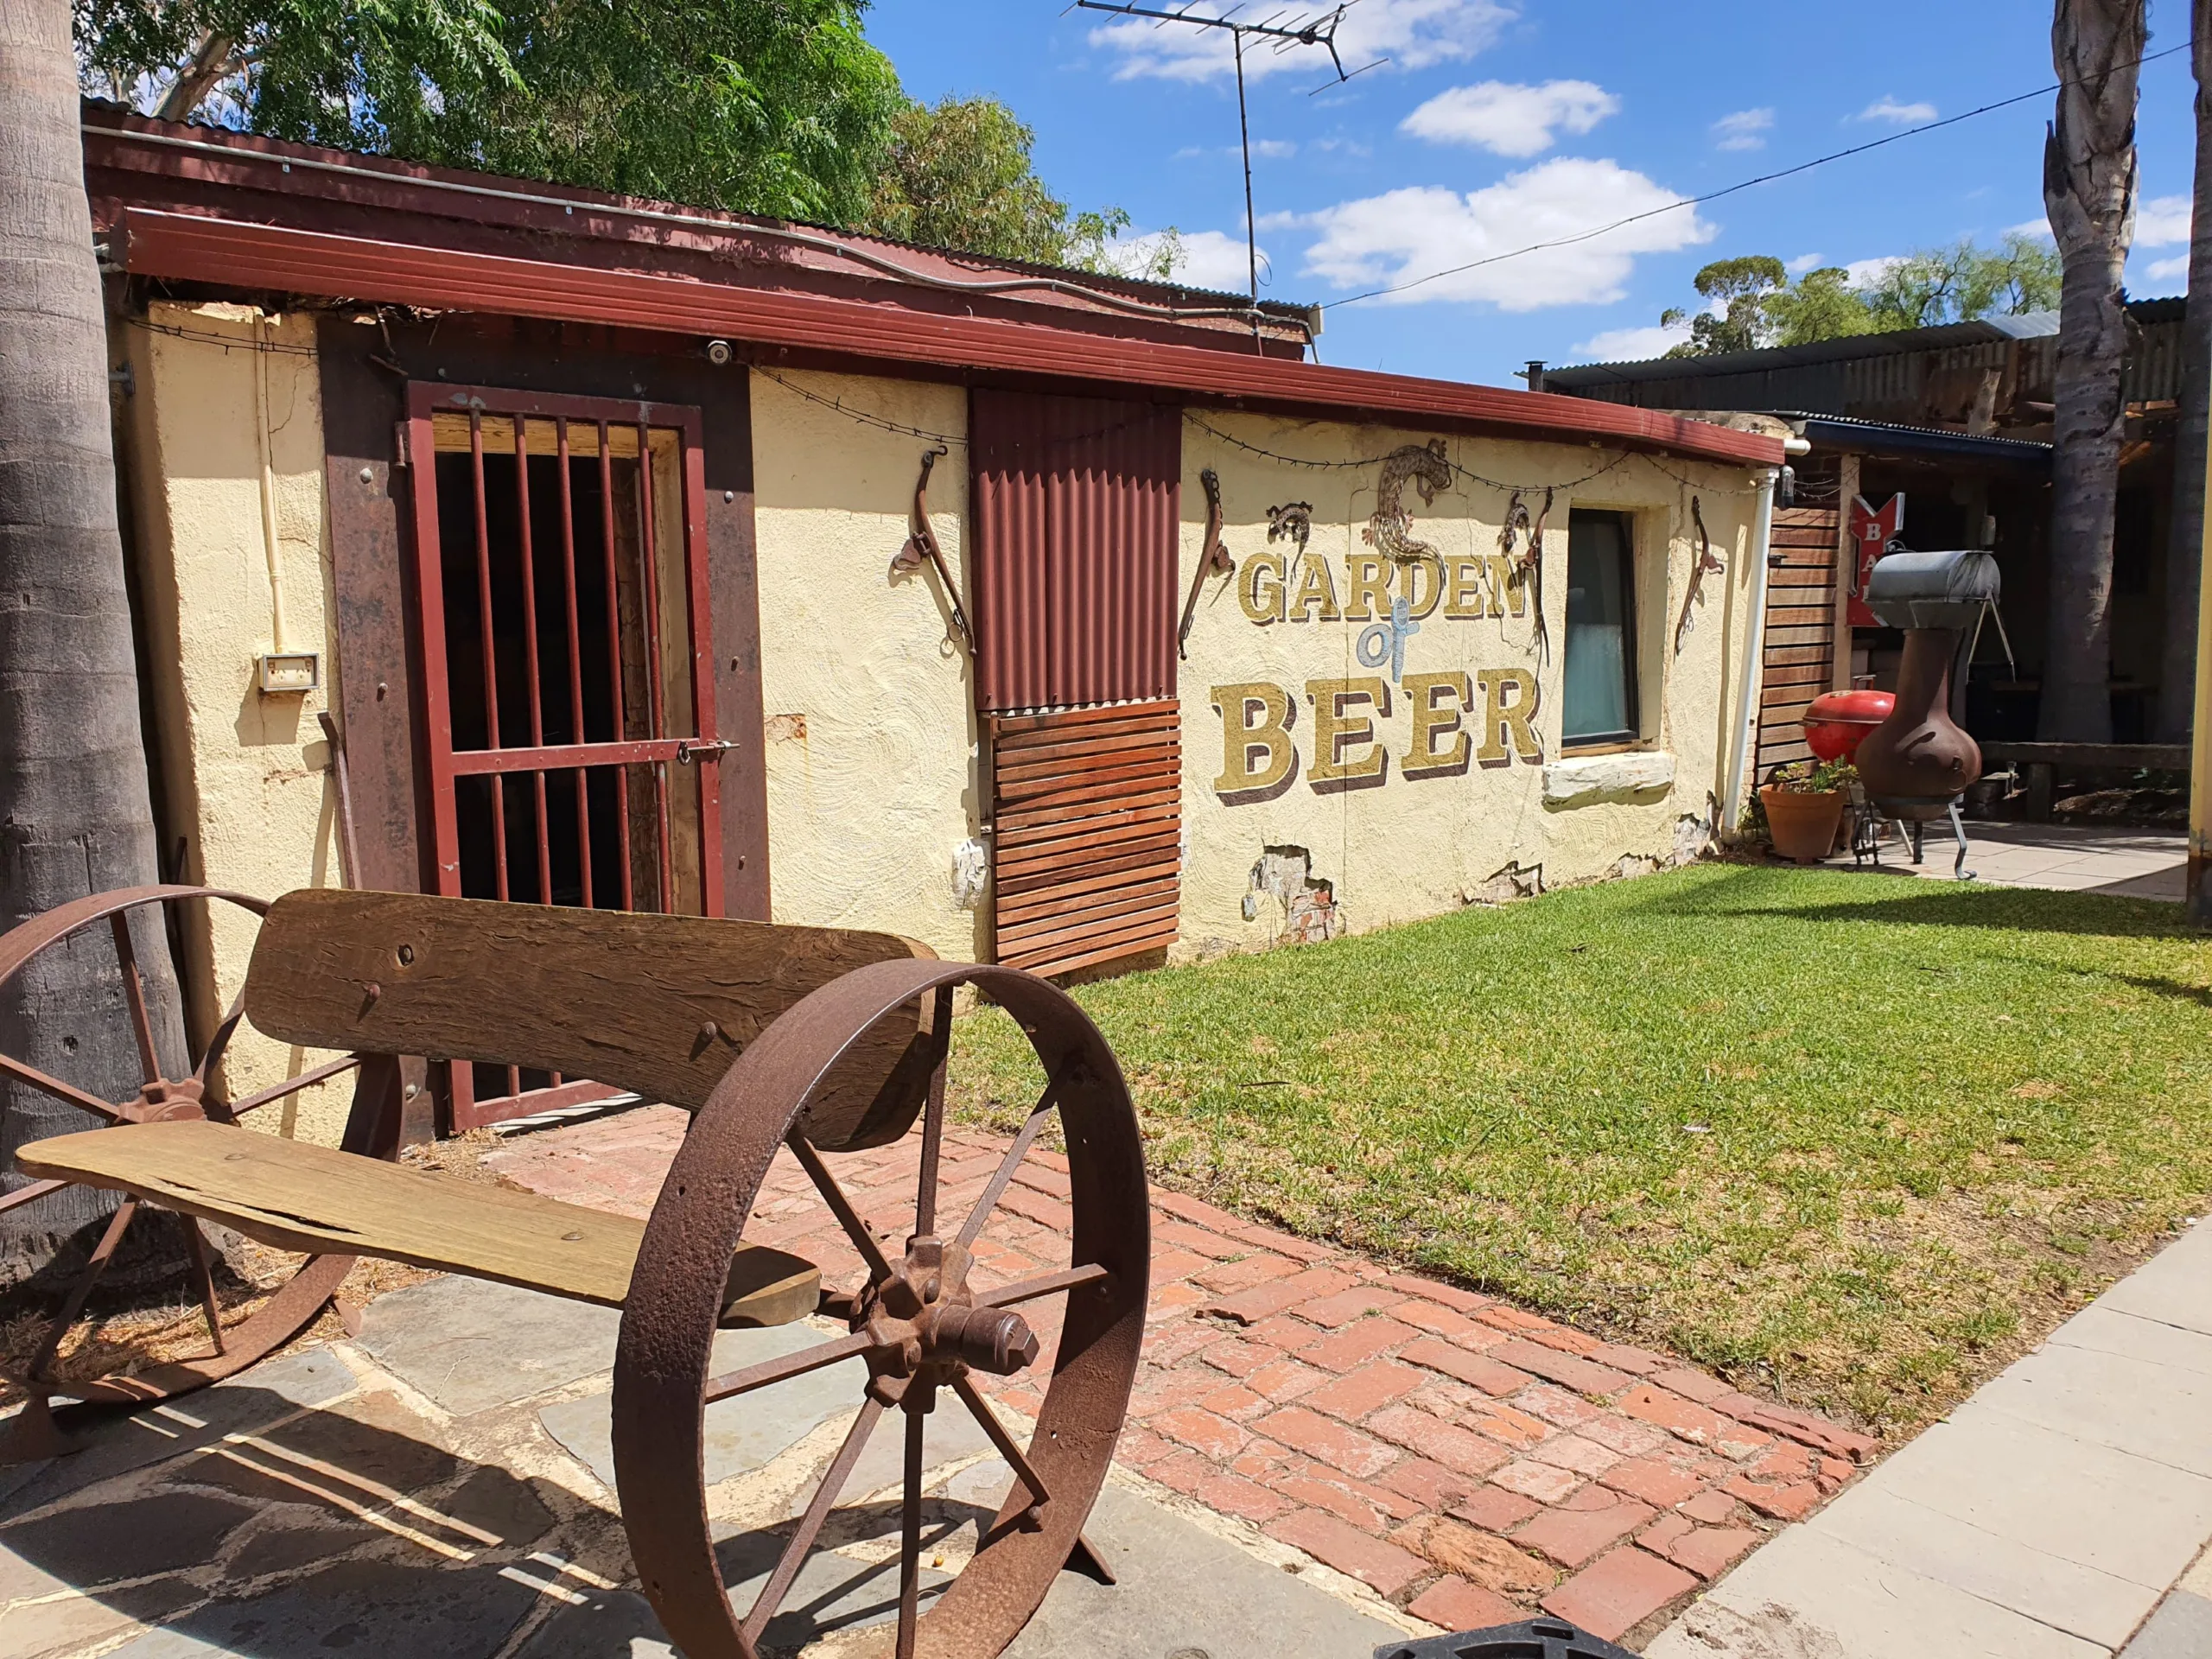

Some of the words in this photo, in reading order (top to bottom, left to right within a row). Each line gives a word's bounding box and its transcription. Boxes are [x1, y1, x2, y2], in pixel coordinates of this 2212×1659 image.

[1236, 551, 1535, 626] GARDEN
[1356, 595, 1421, 683] of
[1211, 667, 1544, 808] BEER
